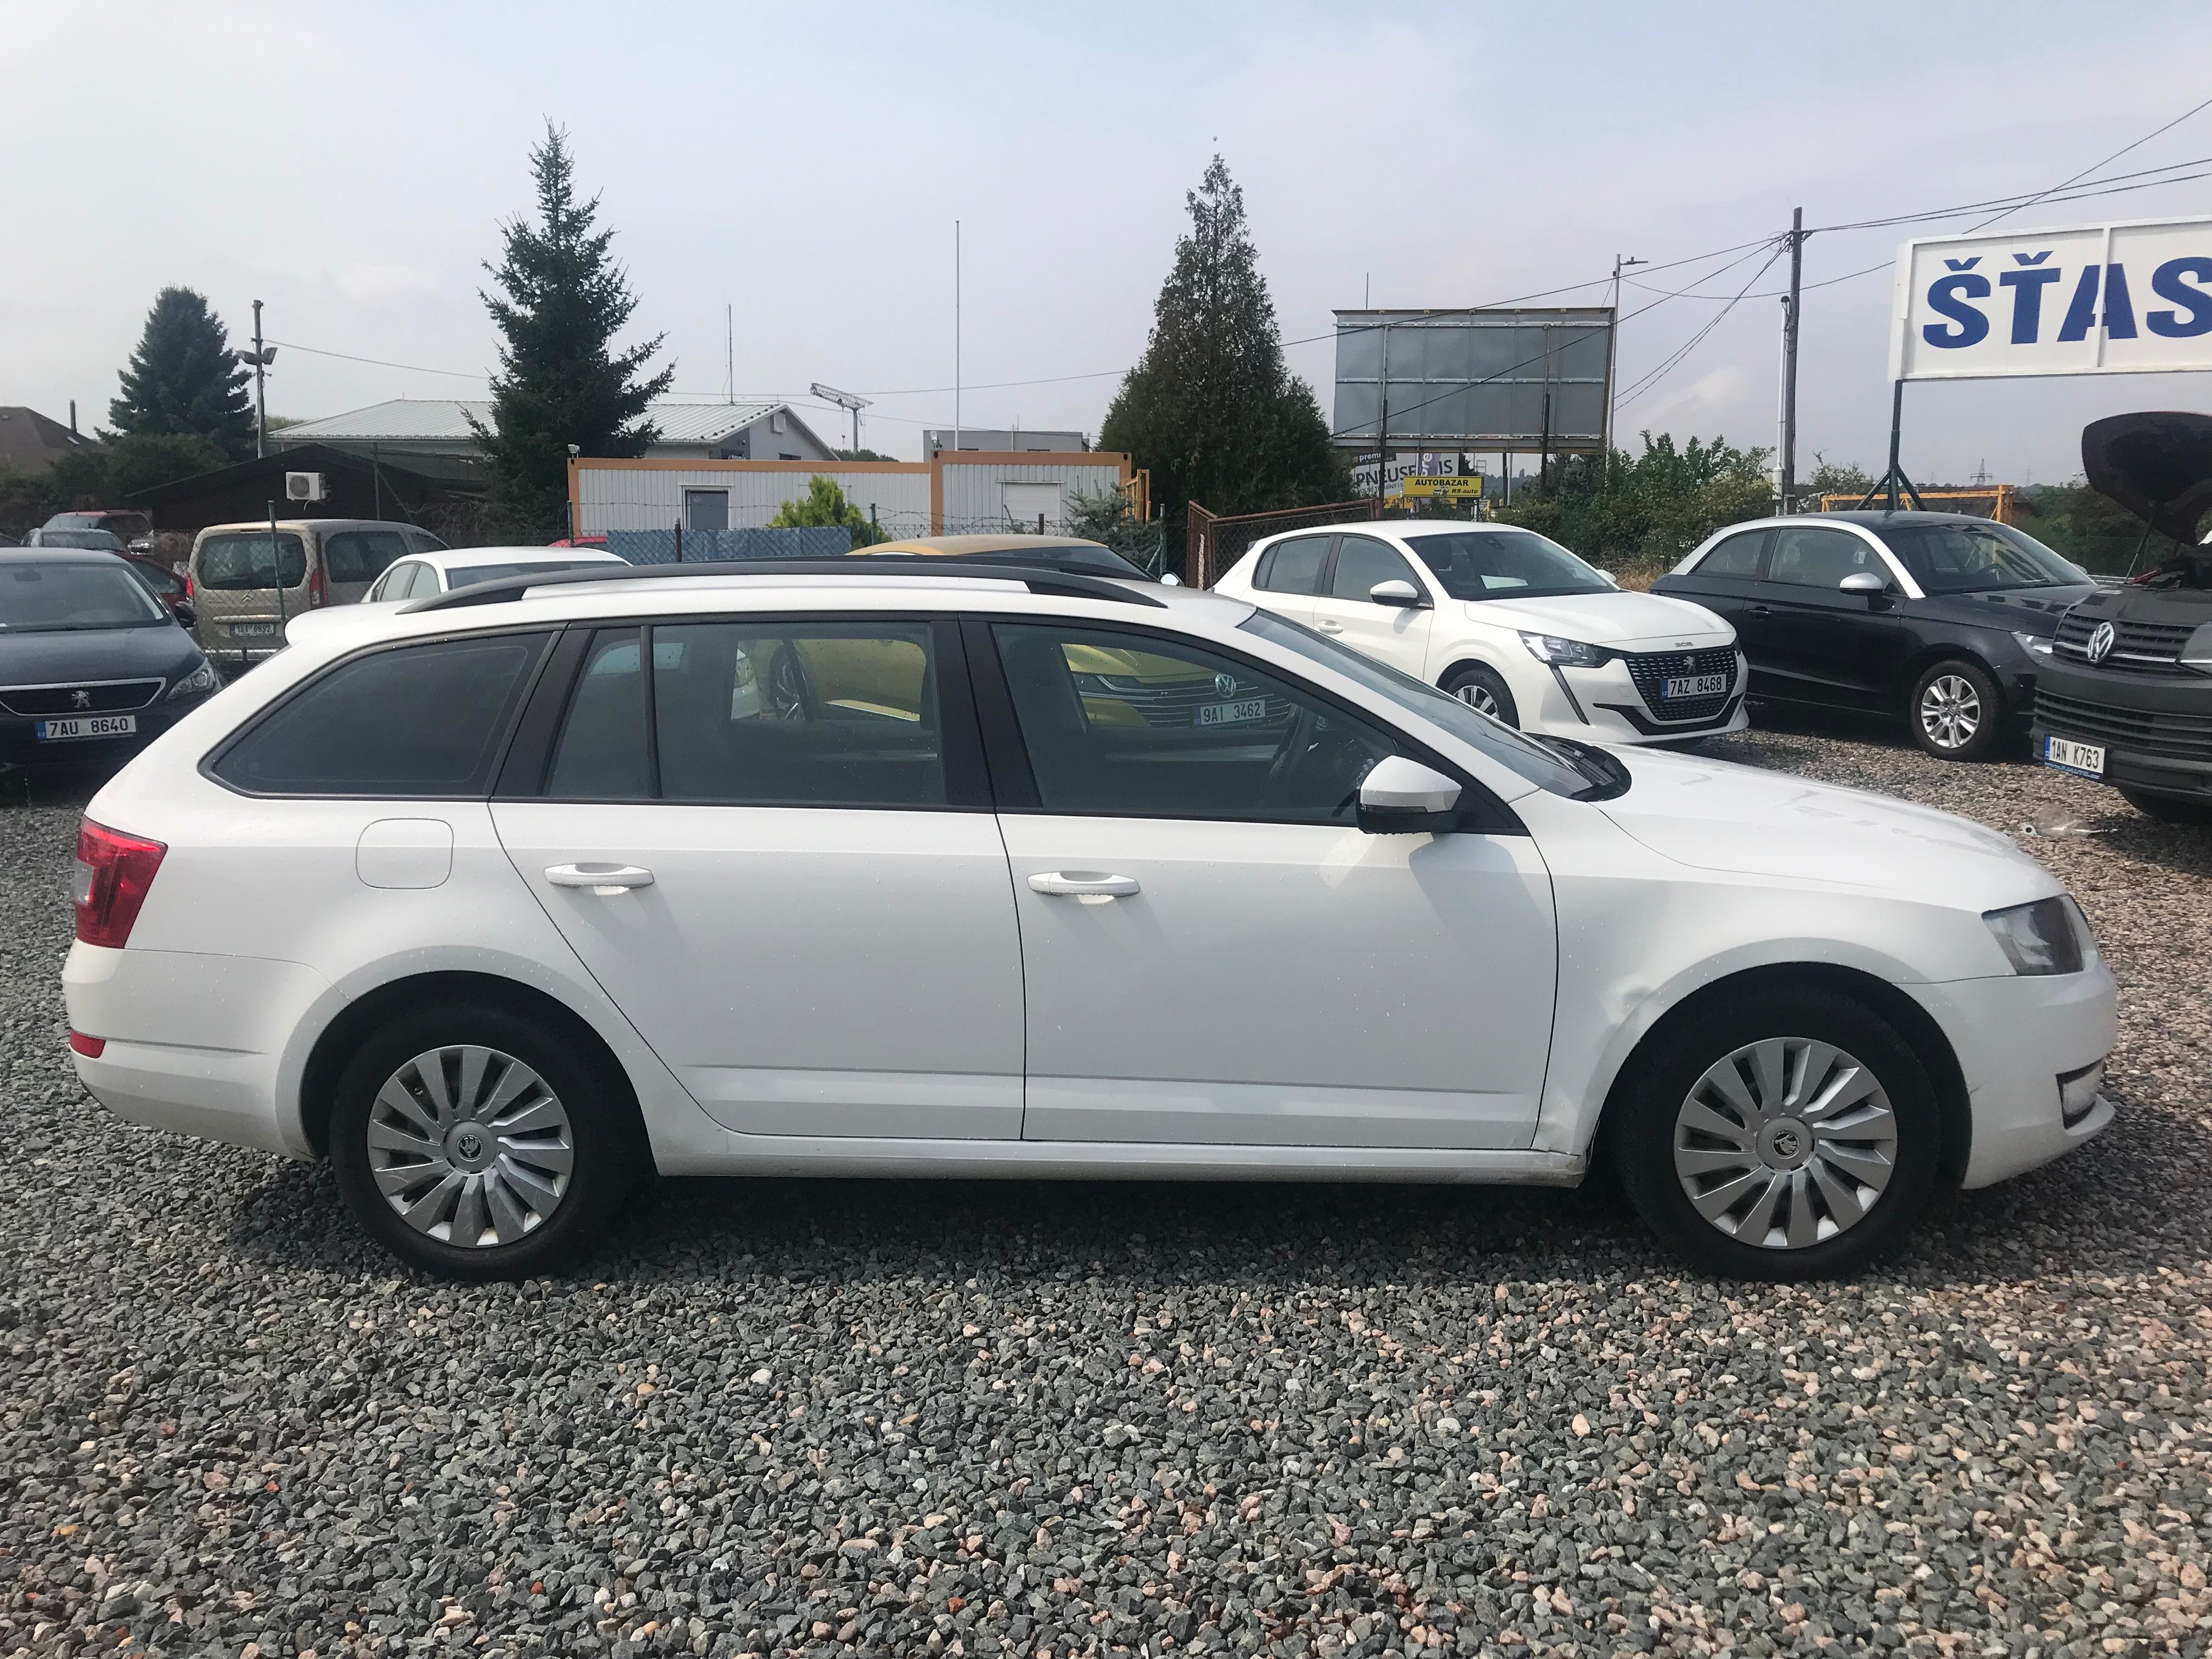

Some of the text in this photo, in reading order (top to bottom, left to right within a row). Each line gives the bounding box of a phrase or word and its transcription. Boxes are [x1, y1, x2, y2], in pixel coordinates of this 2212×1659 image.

[1923, 250, 2212, 349] ŠŤAS
[1671, 676, 1722, 696] 7AZ 8468
[1204, 702, 1260, 722] 9AI 3462
[49, 718, 128, 737] 7AU 8640
[2052, 740, 2100, 769] 1AN K763
